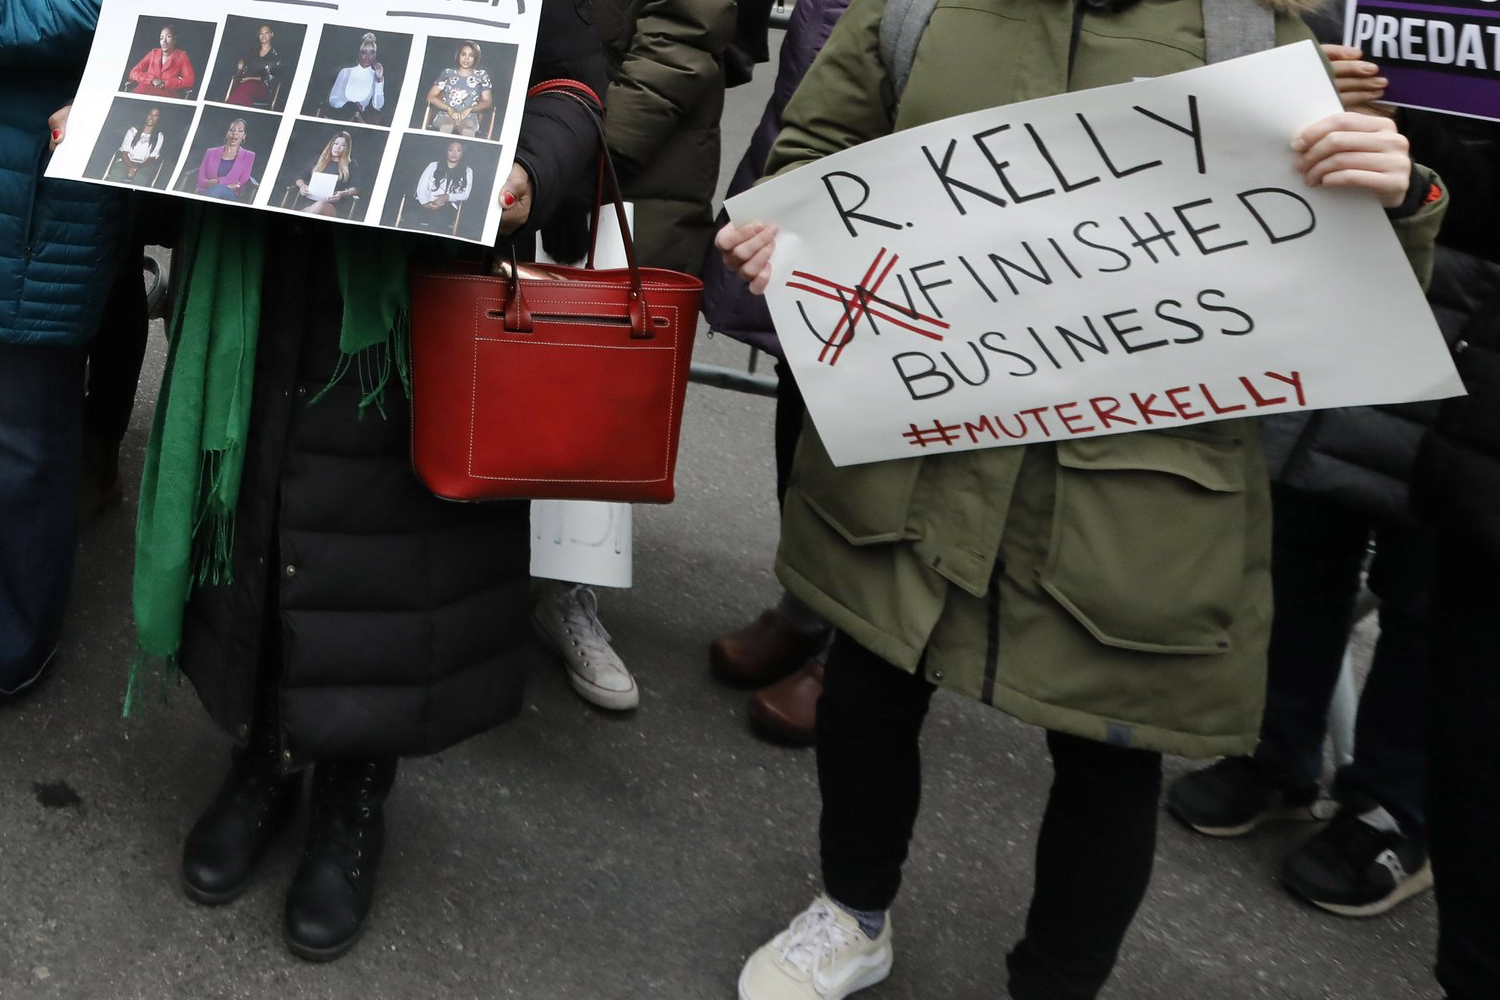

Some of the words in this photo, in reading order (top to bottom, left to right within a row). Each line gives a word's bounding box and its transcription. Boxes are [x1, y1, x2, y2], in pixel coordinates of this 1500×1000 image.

[822, 170, 913, 237] R.
[923, 95, 1206, 215] KELLY
[892, 289, 1255, 401] BUSINESS
[903, 371, 1306, 447] #MUTERKELLY
